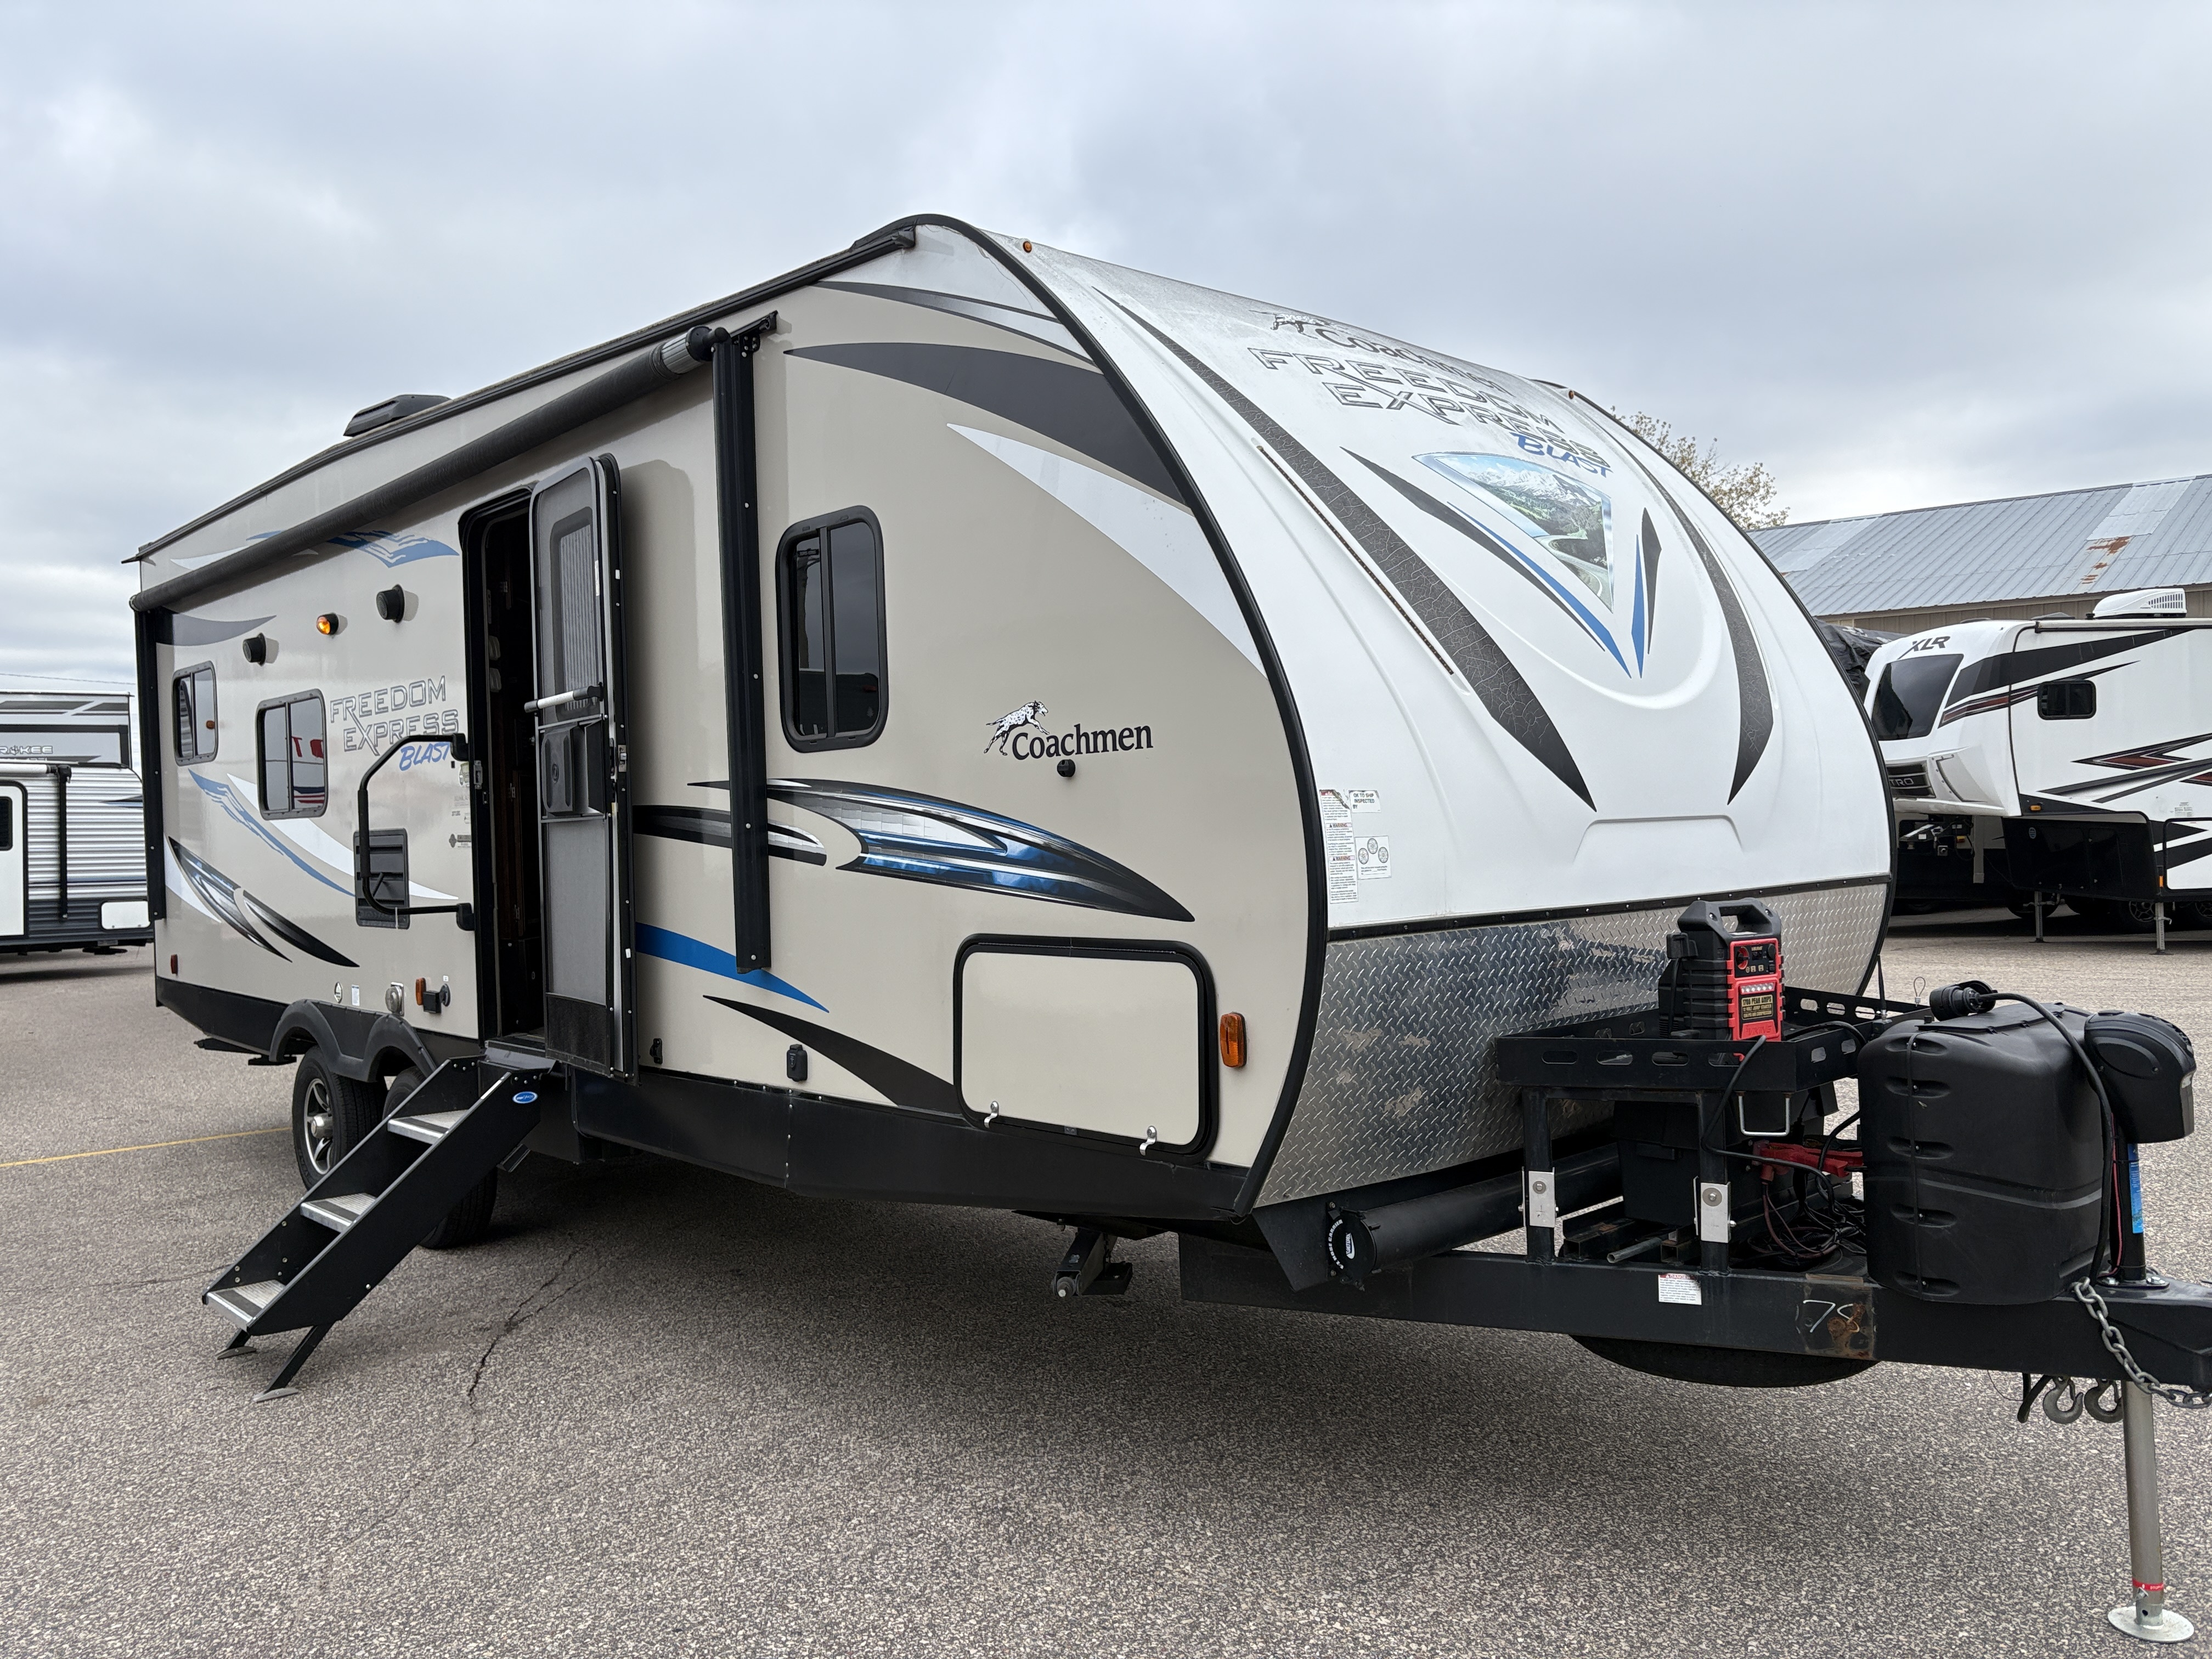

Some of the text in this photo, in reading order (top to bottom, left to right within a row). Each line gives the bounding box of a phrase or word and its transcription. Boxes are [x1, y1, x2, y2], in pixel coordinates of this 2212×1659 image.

[1248, 347, 1566, 434] FREEDOM
[1322, 382, 1611, 468] EXPRESS
[1509, 432, 1614, 478] BLAST
[1897, 636, 1951, 661] XLR
[330, 675, 446, 724] FREEDOM
[343, 709, 459, 757] EXPRESS
[399, 742, 450, 771] BLAST
[1012, 723, 1153, 760] Coachmen
